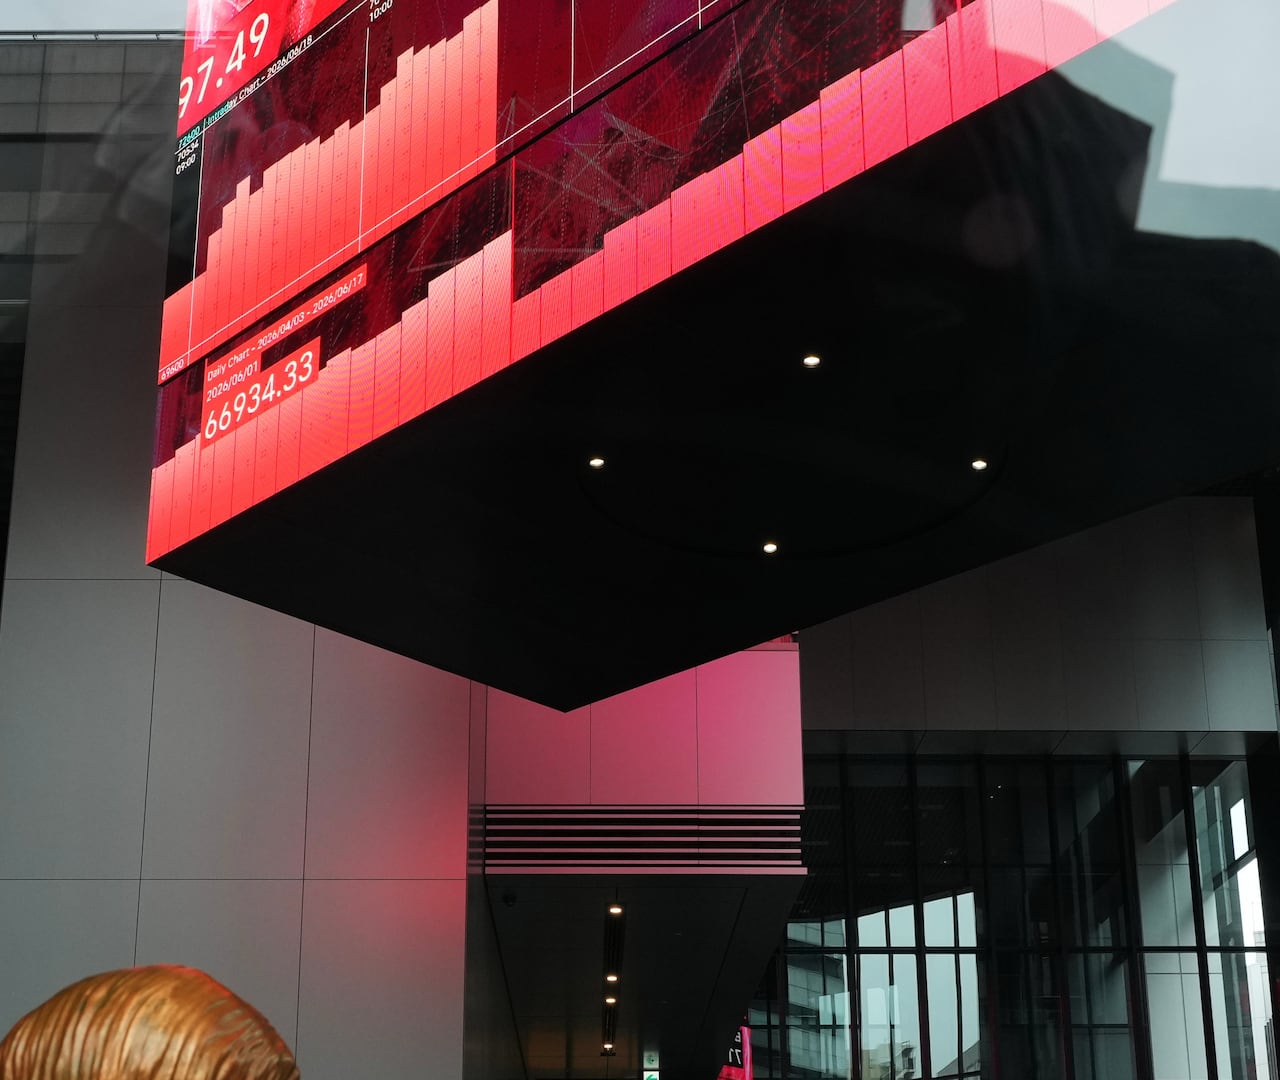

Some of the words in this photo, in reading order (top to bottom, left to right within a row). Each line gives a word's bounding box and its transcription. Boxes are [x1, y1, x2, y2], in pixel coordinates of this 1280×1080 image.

[369, 0, 393, 22] 10:00
[208, 96, 238, 125] Intraday
[239, 78, 261, 100] Chart
[266, 34, 313, 78] 2026/06/18
[176, 153, 196, 175] 09:00
[207, 364, 226, 382] Daily
[228, 349, 250, 368] Chart
[257, 311, 305, 349] 2026/04/03
[312, 273, 364, 314] 2026/06/17
[161, 358, 185, 381] 69600
[207, 360, 258, 402] 2026/06/01
[204, 351, 313, 440] 66934.33
